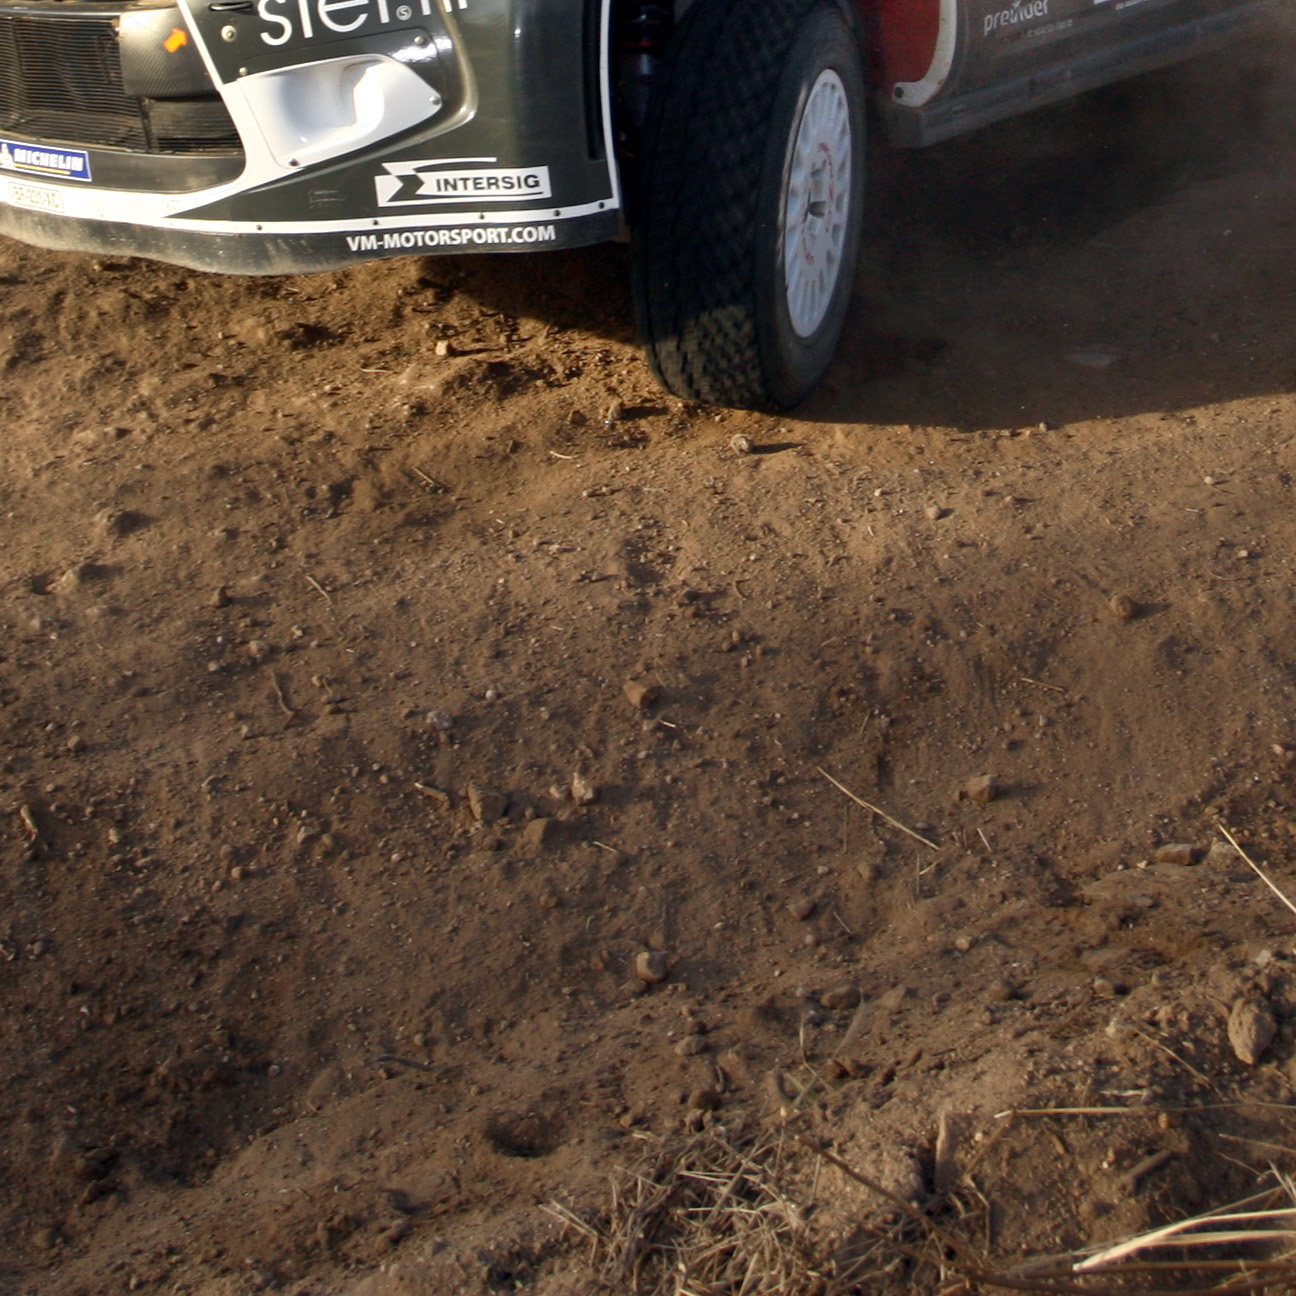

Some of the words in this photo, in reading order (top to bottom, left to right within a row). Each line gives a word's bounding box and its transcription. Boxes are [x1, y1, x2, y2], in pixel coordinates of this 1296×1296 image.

[13, 148, 84, 172] MICHELIN
[435, 173, 541, 193] INTERSIG
[346, 224, 557, 252] VM-MOTORSPORT.COM
